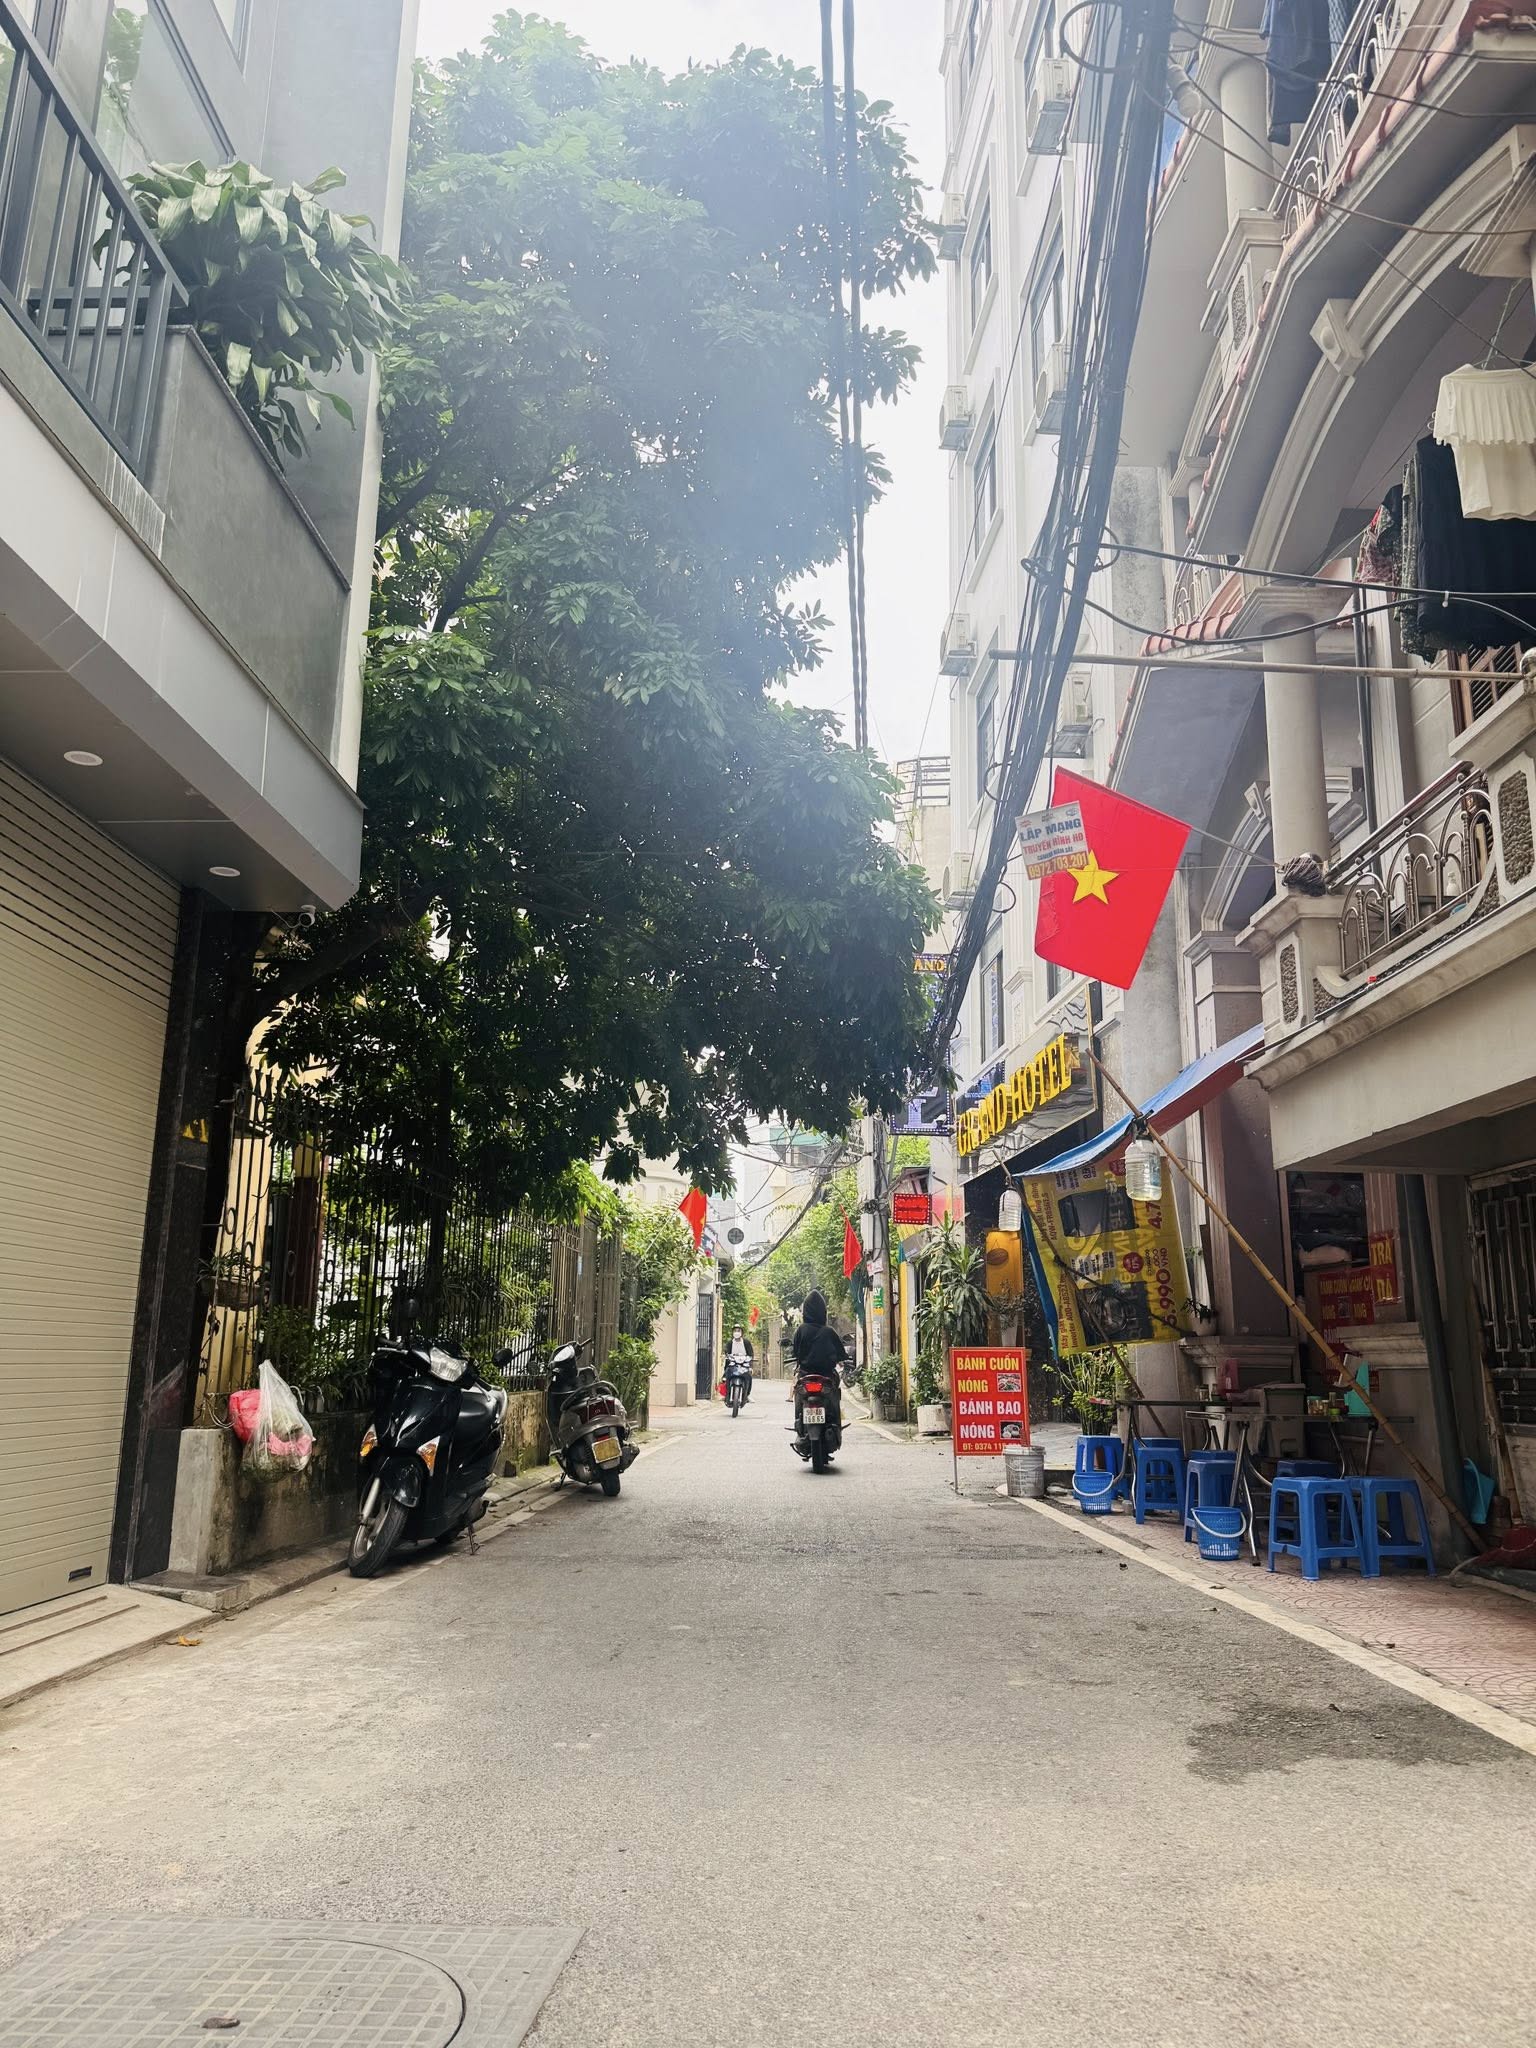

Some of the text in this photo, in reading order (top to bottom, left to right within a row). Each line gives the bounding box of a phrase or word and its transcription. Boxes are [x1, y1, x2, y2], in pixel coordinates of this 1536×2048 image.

[1045, 818, 1082, 836] MẠNG
[1010, 1032, 1072, 1125] HOTEL
[956, 1353, 1020, 1371] BÁNH CUỐN
[958, 1377, 989, 1393] NÓNG
[959, 1398, 1021, 1415] BÁNH BAO
[960, 1422, 995, 1439] NÓNG
